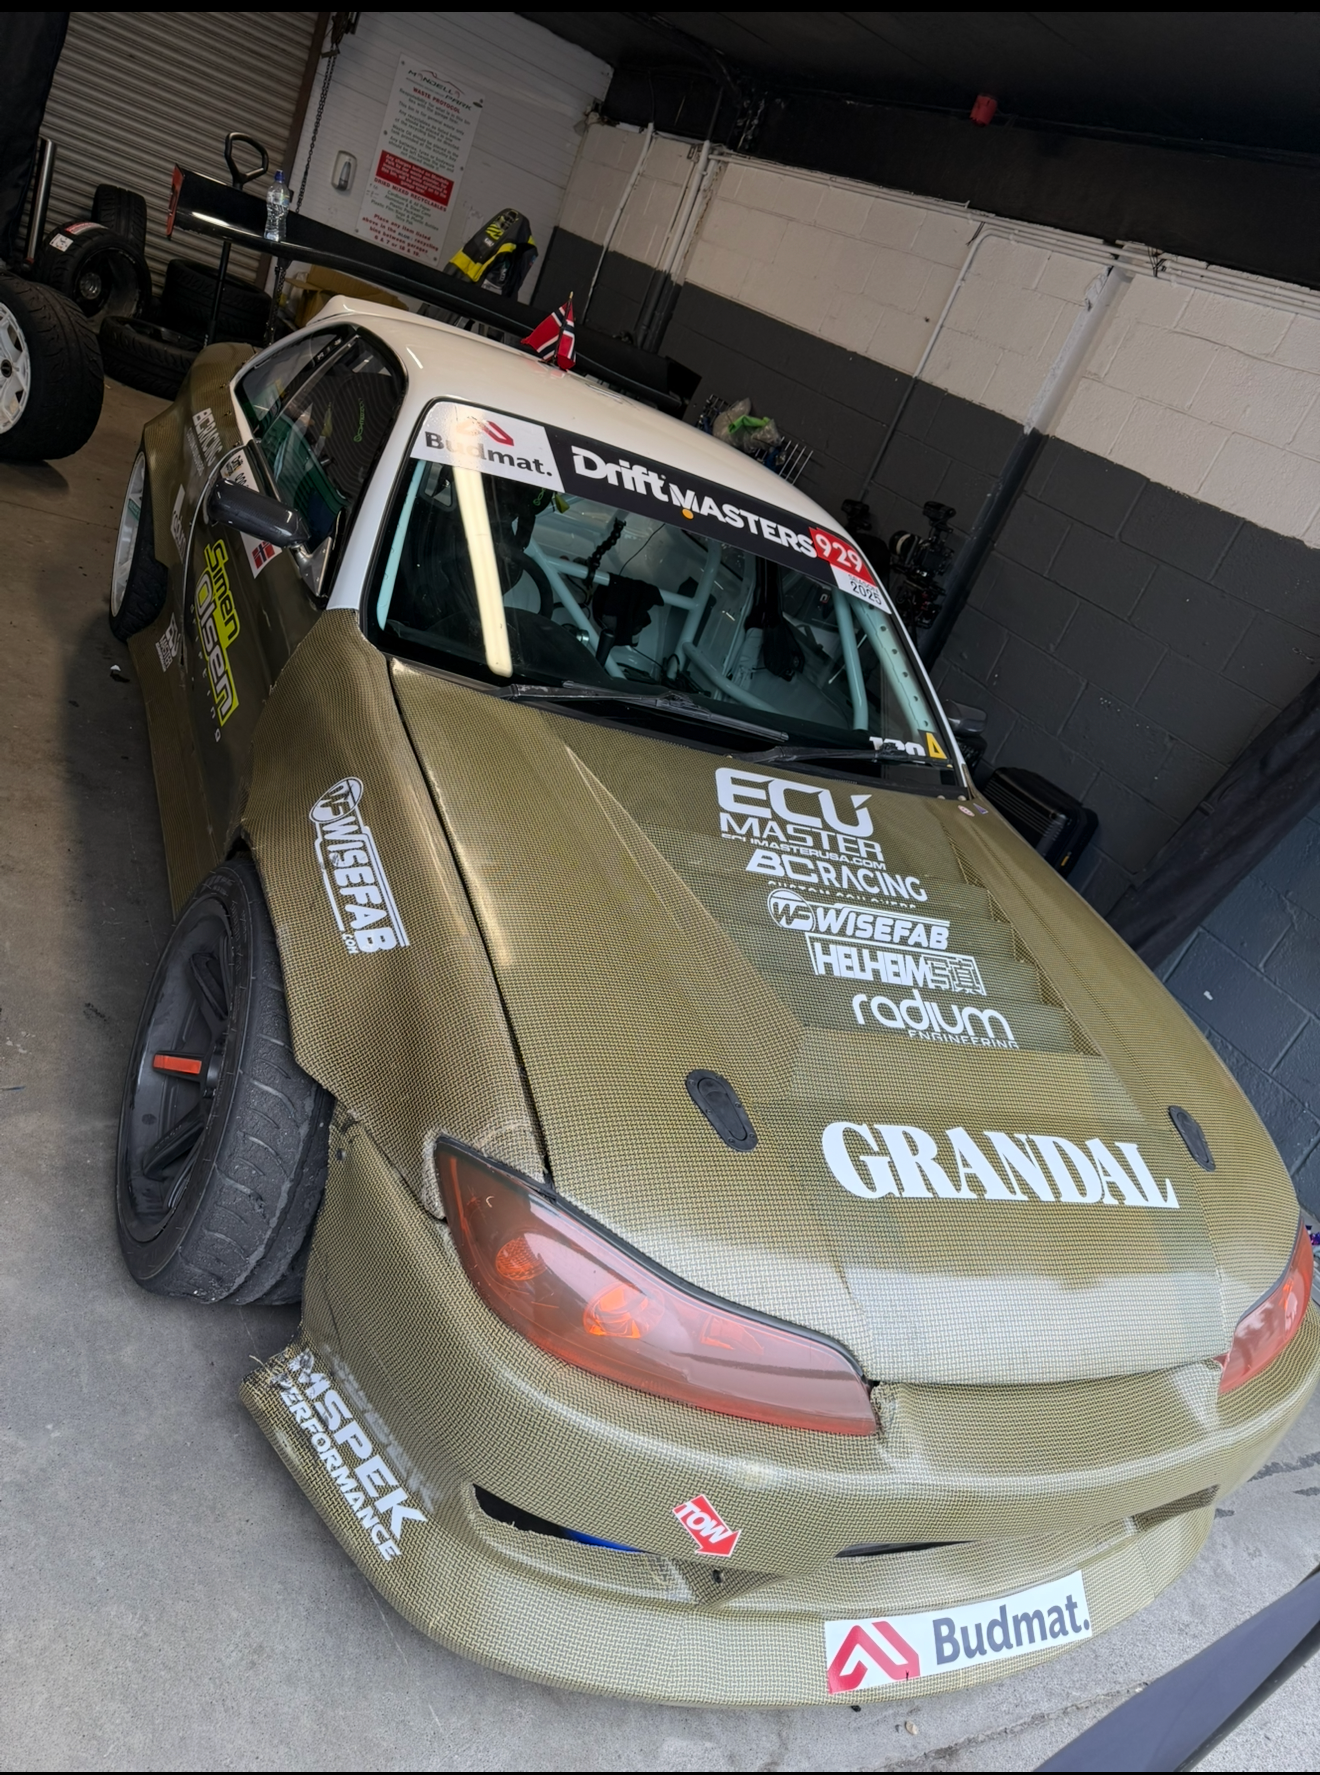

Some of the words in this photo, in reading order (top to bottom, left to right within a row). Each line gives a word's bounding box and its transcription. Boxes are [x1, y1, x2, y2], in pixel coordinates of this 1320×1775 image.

[413, 86, 431, 99] WASTE
[432, 96, 460, 114] PROTOCOL
[392, 185, 409, 195] MIXED
[424, 431, 553, 477] Budmat.
[571, 445, 669, 502] Drift
[669, 483, 818, 559] MASTERS
[815, 533, 863, 573] 929
[207, 541, 238, 642] Simen
[850, 580, 882, 606] 2025
[197, 573, 234, 717] Olsen
[715, 767, 874, 837] ECU
[719, 812, 885, 861] MASTER
[322, 815, 398, 953] WISEFAB
[816, 906, 949, 950] WISEFAB
[813, 942, 934, 988] HELHEIM
[852, 989, 1015, 1041] radium
[908, 1030, 1019, 1049] ENGINEERING
[822, 1121, 1180, 1208] GRANDAL
[675, 1501, 733, 1544] TOW
[932, 1594, 1090, 1665] Budmat.
